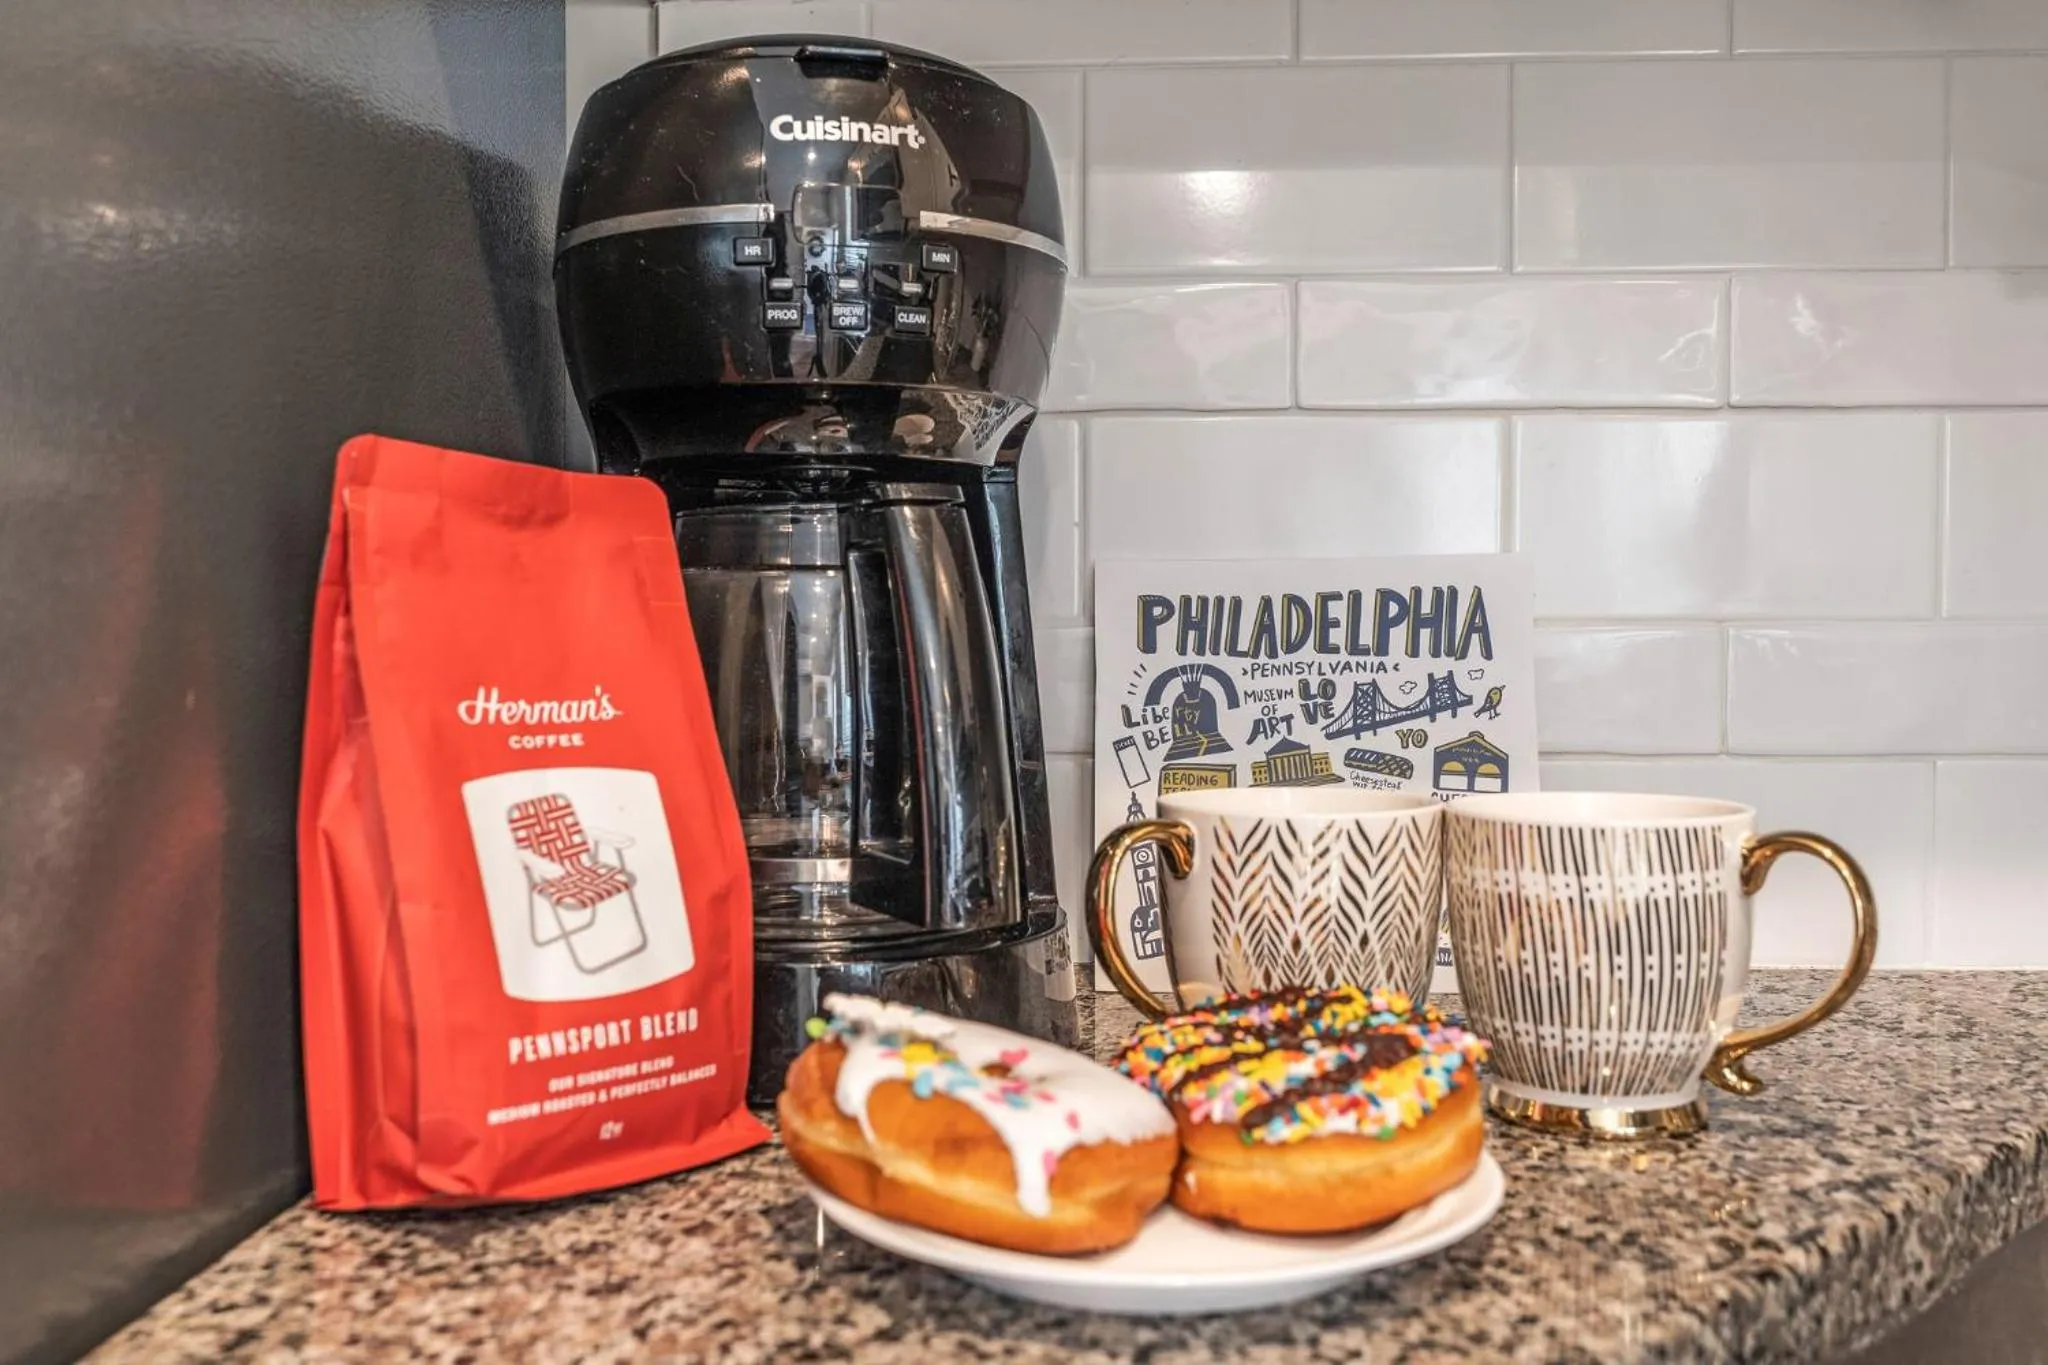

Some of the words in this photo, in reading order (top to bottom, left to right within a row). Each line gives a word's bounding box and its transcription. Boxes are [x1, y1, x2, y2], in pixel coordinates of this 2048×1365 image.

[769, 114, 921, 149] Cuisinart
[744, 245, 762, 257] HR
[931, 251, 950, 263] MIN
[767, 308, 798, 320] PROG
[839, 315, 859, 326] OFF
[897, 313, 927, 324] CLEAN
[1137, 585, 1493, 661] PHILADELPHIA
[1250, 660, 1388, 680] PENNSYLVANIA
[457, 684, 624, 726] Herman's
[1260, 704, 1279, 717] OF
[1246, 713, 1295, 746] ART
[1395, 728, 1429, 749] YO
[508, 733, 585, 749] COFFEE
[508, 1019, 632, 1065] PENNSPORT
[640, 1007, 699, 1042] BLEND
[548, 1074, 575, 1093] OUR
[576, 1062, 639, 1088] SIGNATURE
[640, 1055, 675, 1074] BLEND
[486, 1102, 541, 1126] MEDIUM
[542, 1090, 596, 1115] ROASTED
[598, 1088, 608, 1104] &
[610, 1077, 669, 1101] PERFECTLY
[669, 1063, 718, 1088] BALANCED
